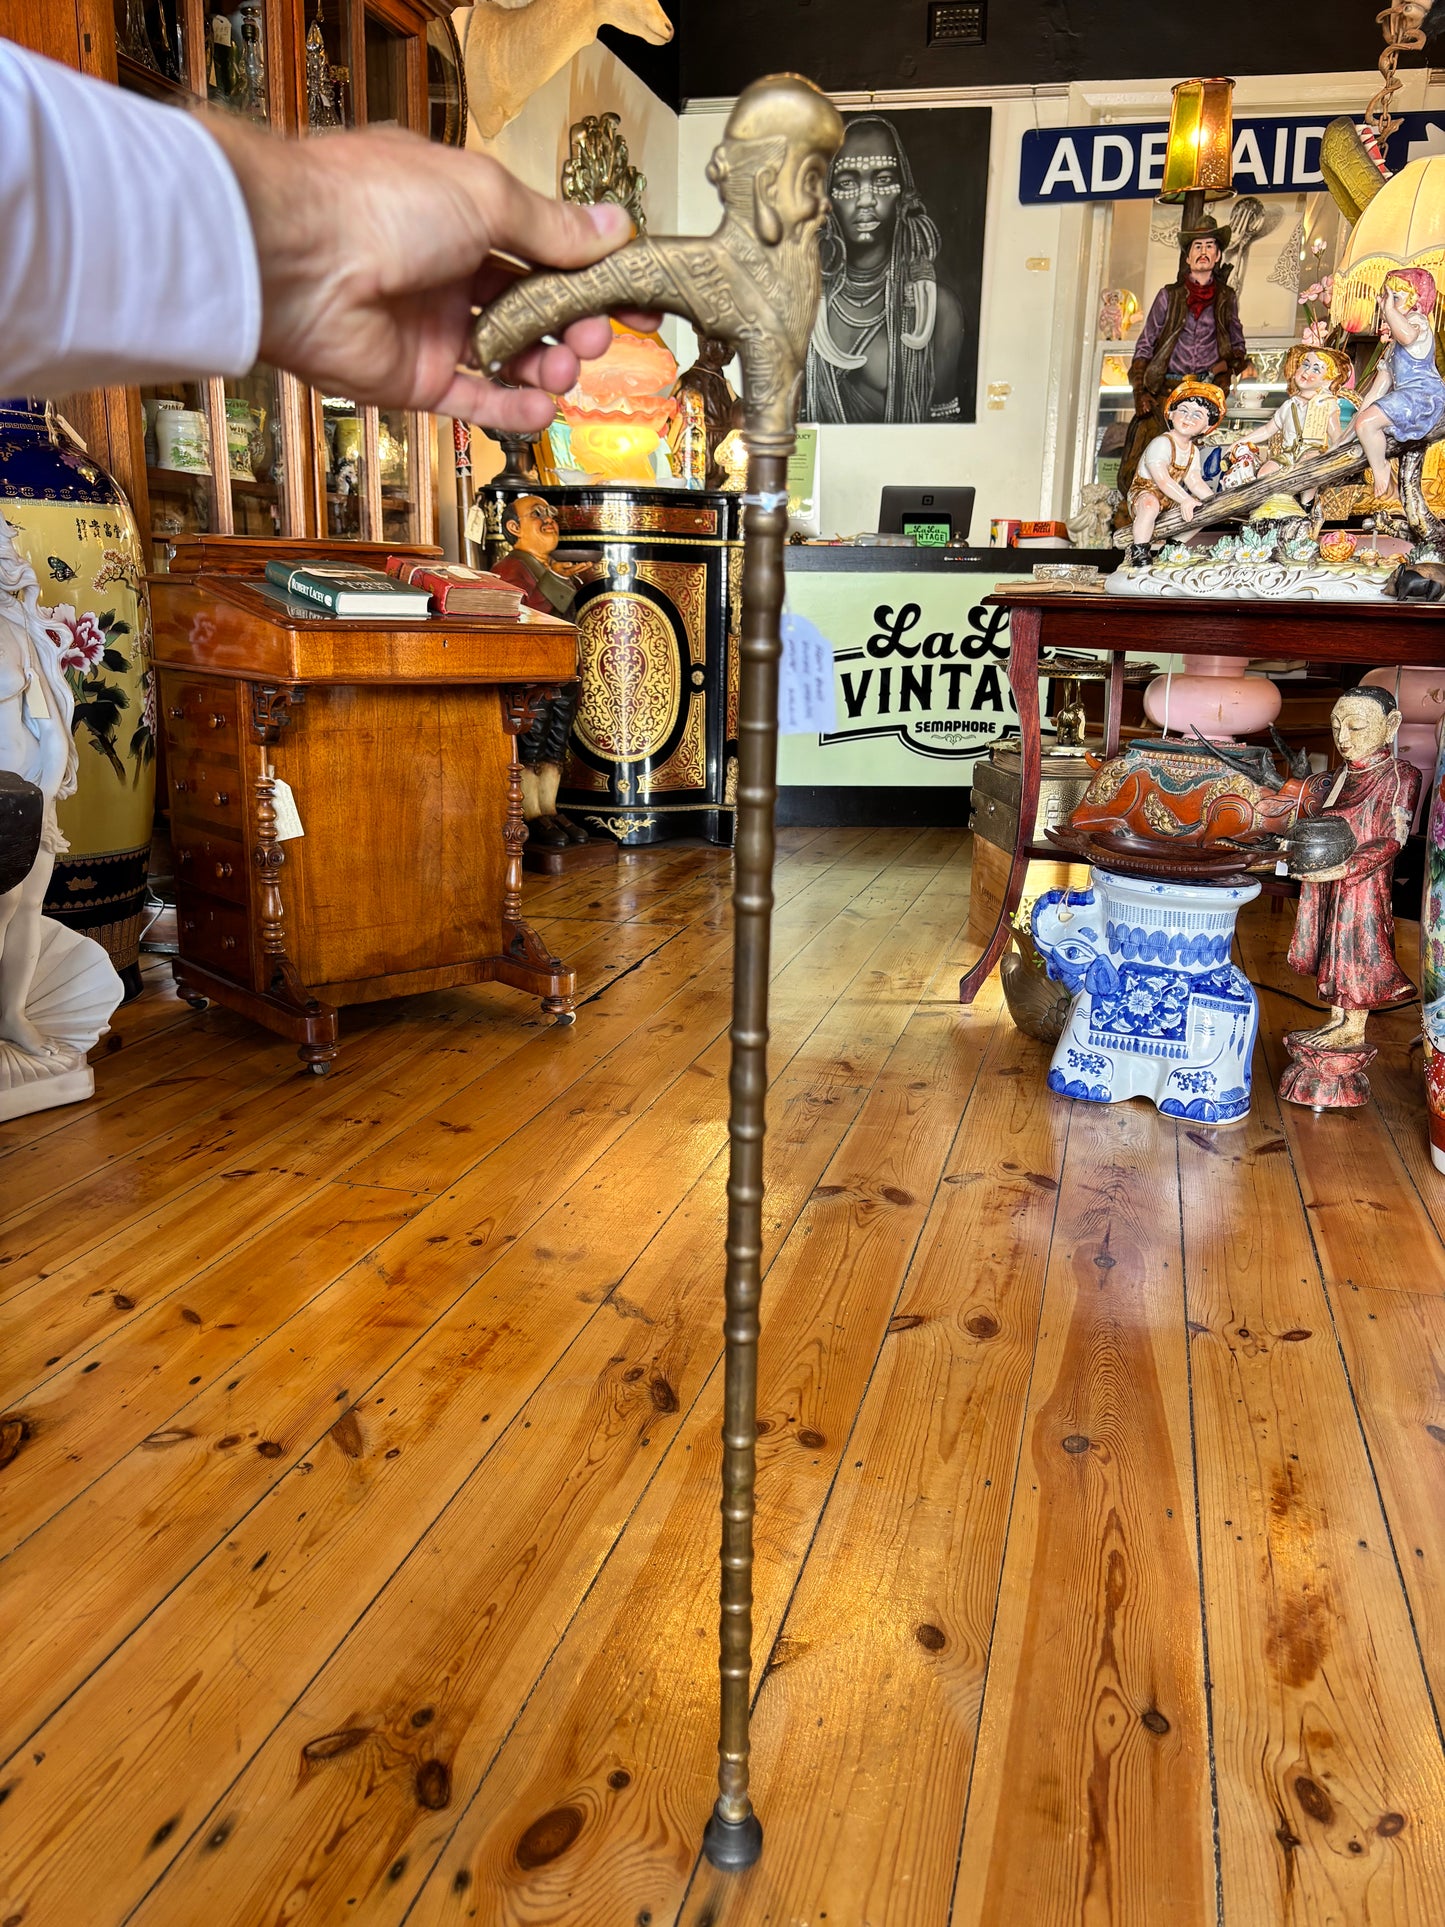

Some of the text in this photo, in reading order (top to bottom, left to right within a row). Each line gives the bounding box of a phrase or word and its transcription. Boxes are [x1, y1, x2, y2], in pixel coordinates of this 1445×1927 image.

[1039, 126, 1379, 195] ADEAID
[309, 586, 325, 603] LACEY
[840, 663, 1056, 719] VINTA
[915, 720, 996, 733] SEMAPHORE
